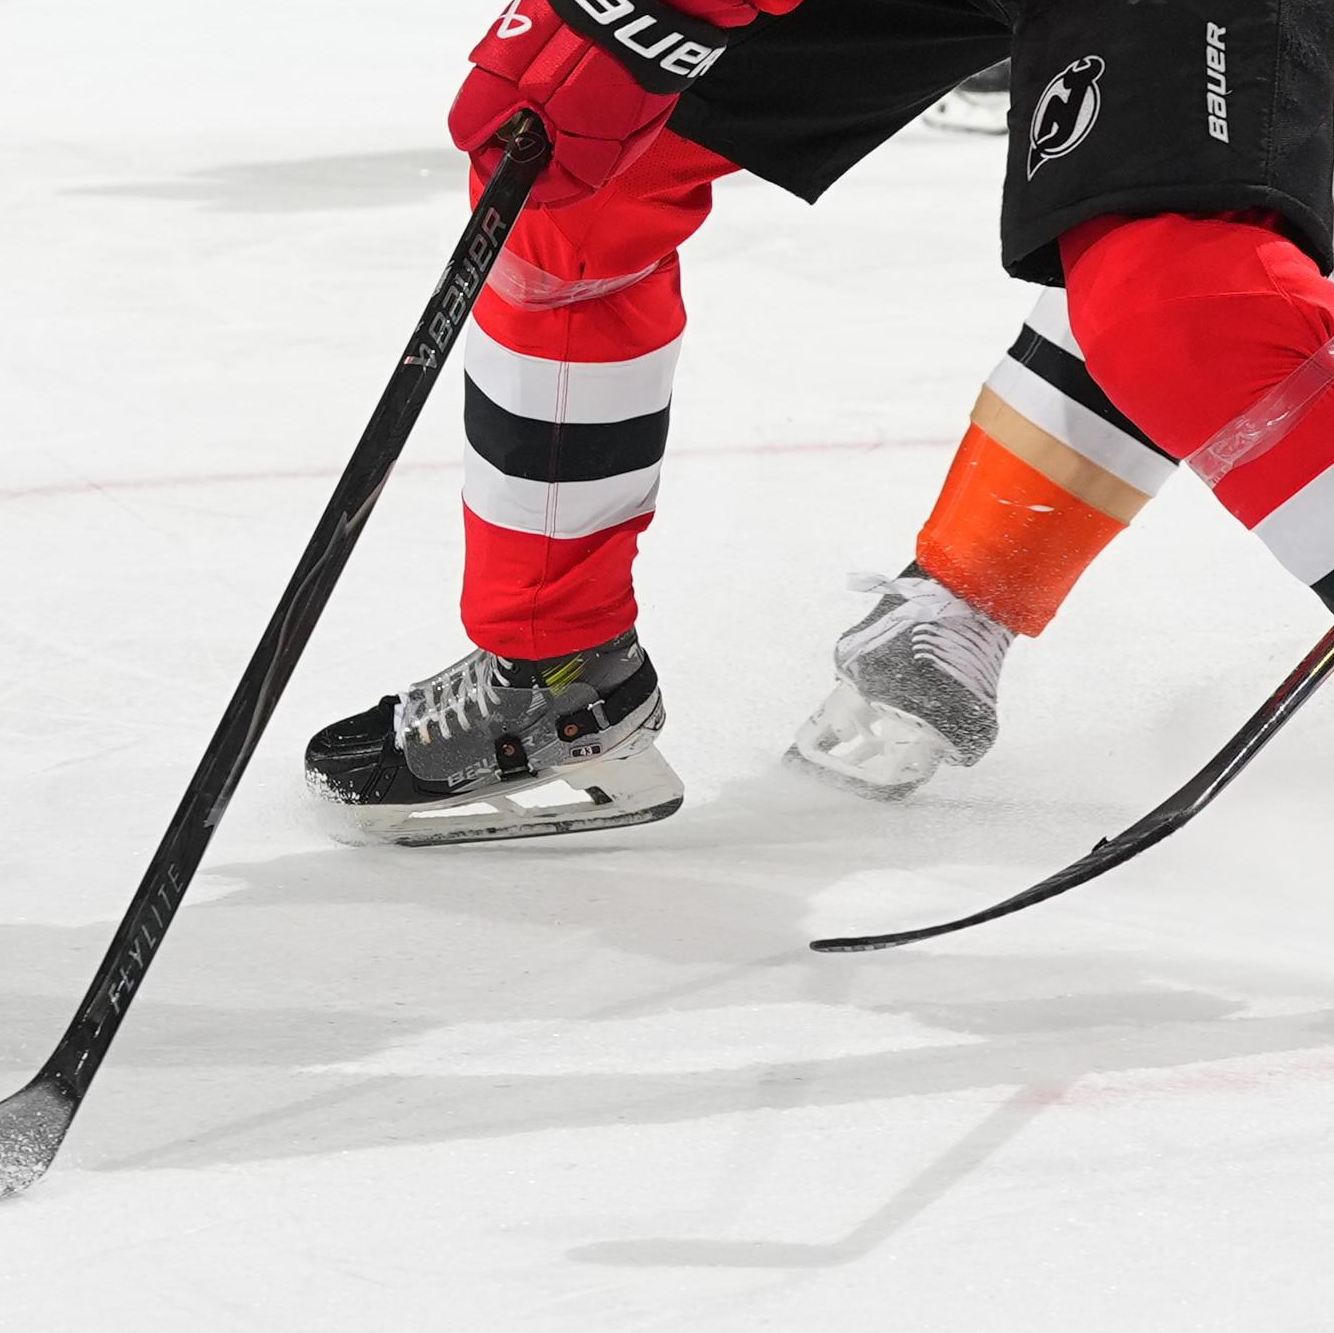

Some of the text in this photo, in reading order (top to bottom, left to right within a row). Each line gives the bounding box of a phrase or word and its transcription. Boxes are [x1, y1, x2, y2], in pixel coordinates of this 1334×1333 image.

[1206, 22, 1230, 144] BAUER
[427, 206, 507, 345] BAUER
[106, 862, 181, 1015] FLYLITE
